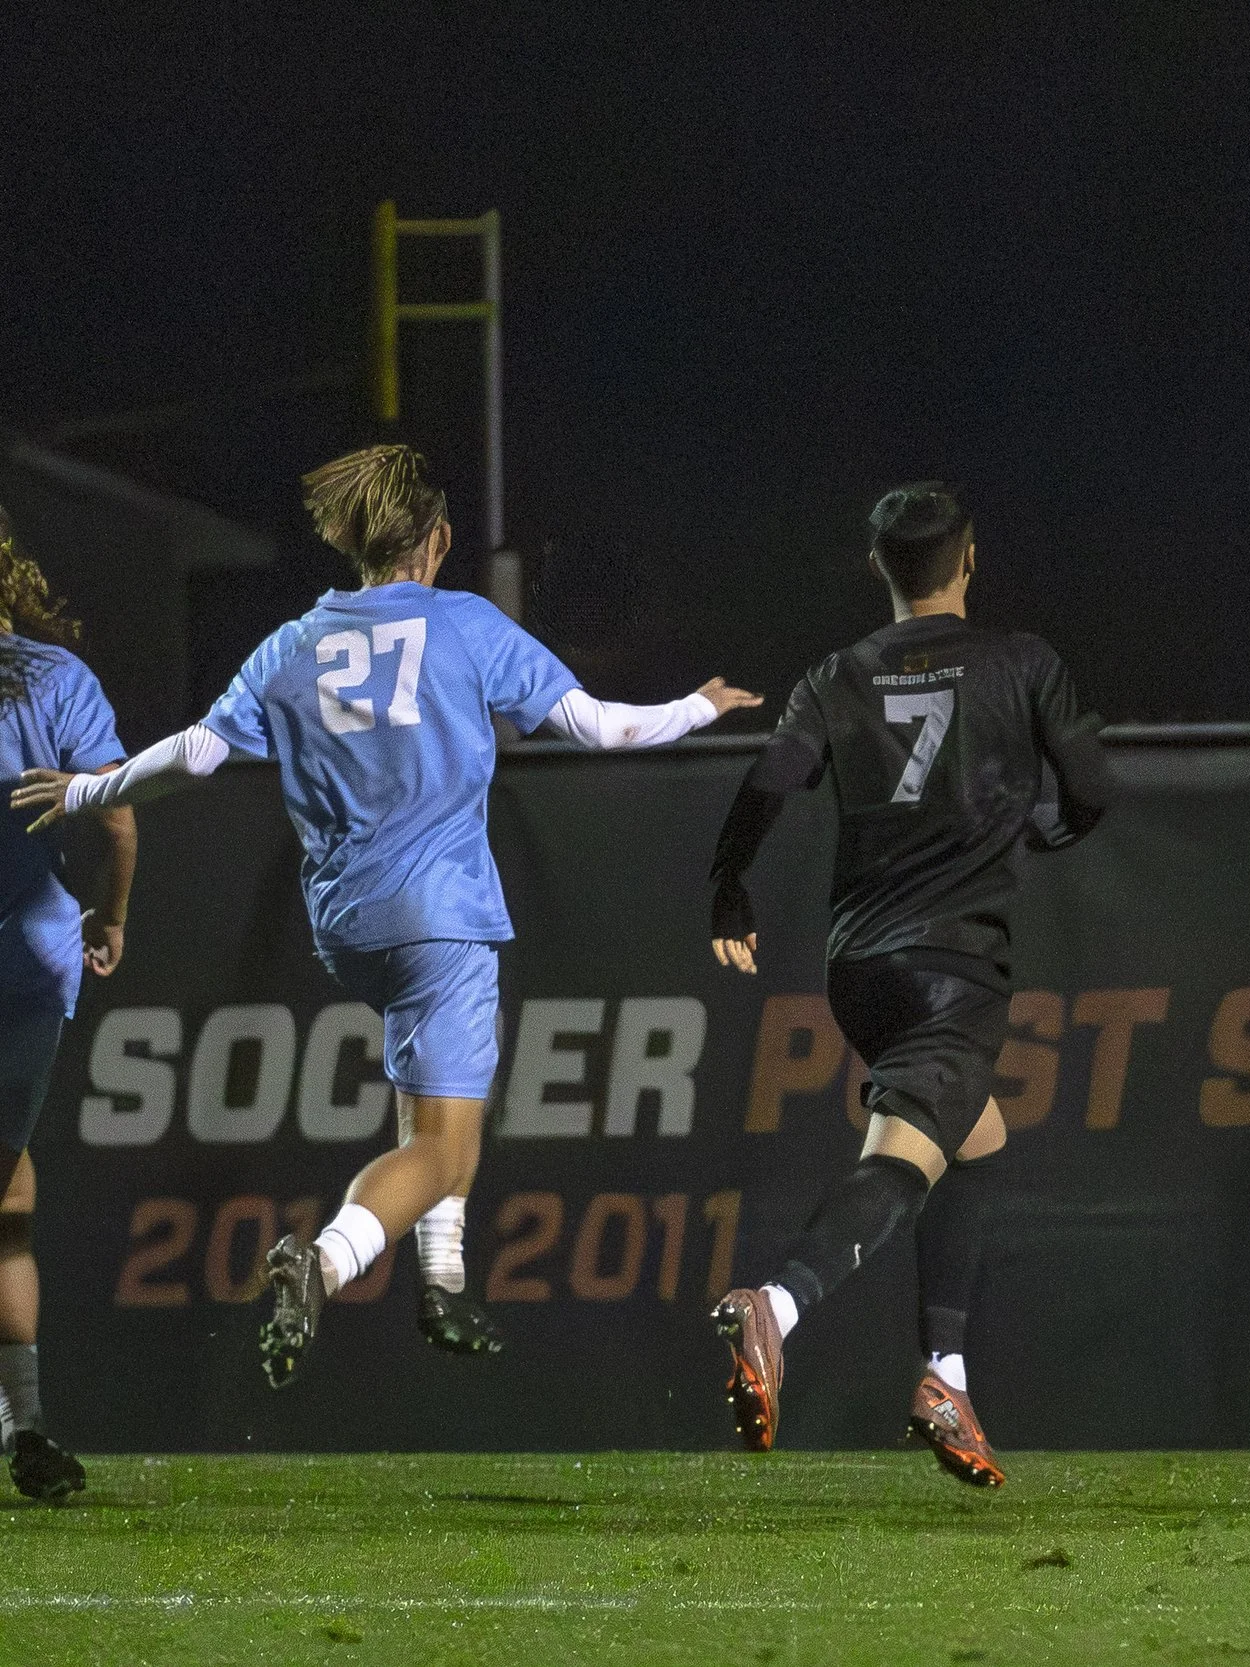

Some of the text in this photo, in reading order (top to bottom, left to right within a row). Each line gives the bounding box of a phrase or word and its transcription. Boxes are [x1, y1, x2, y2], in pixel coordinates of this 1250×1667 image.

[315, 617, 427, 734] 27
[872, 673, 926, 686] OREGON
[883, 689, 955, 802] 7
[78, 997, 707, 1146] SOCER
[743, 987, 1173, 1133] PST
[115, 1189, 742, 1307] 20 2011
